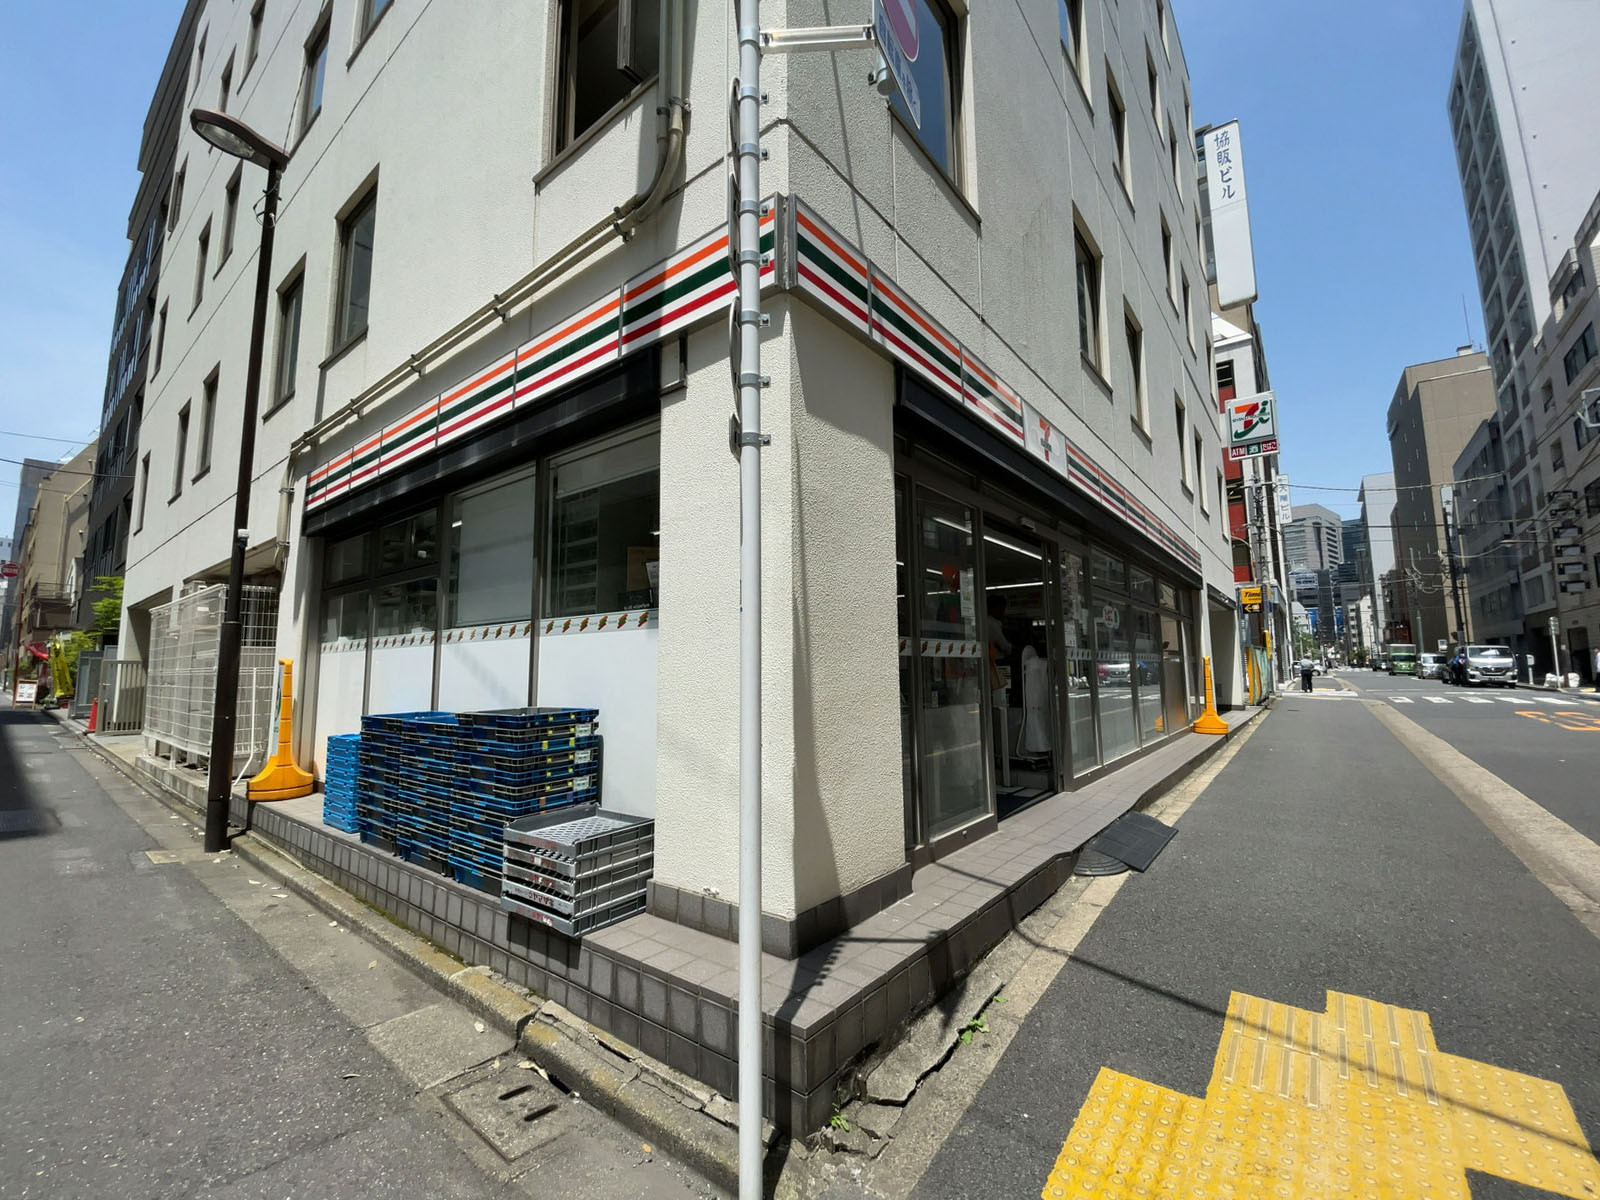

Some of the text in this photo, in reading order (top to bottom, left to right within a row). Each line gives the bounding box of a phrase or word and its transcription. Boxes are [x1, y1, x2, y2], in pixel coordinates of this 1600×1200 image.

[1213, 130, 1236, 200] 協販ビル
[1232, 447, 1245, 457] ATM
